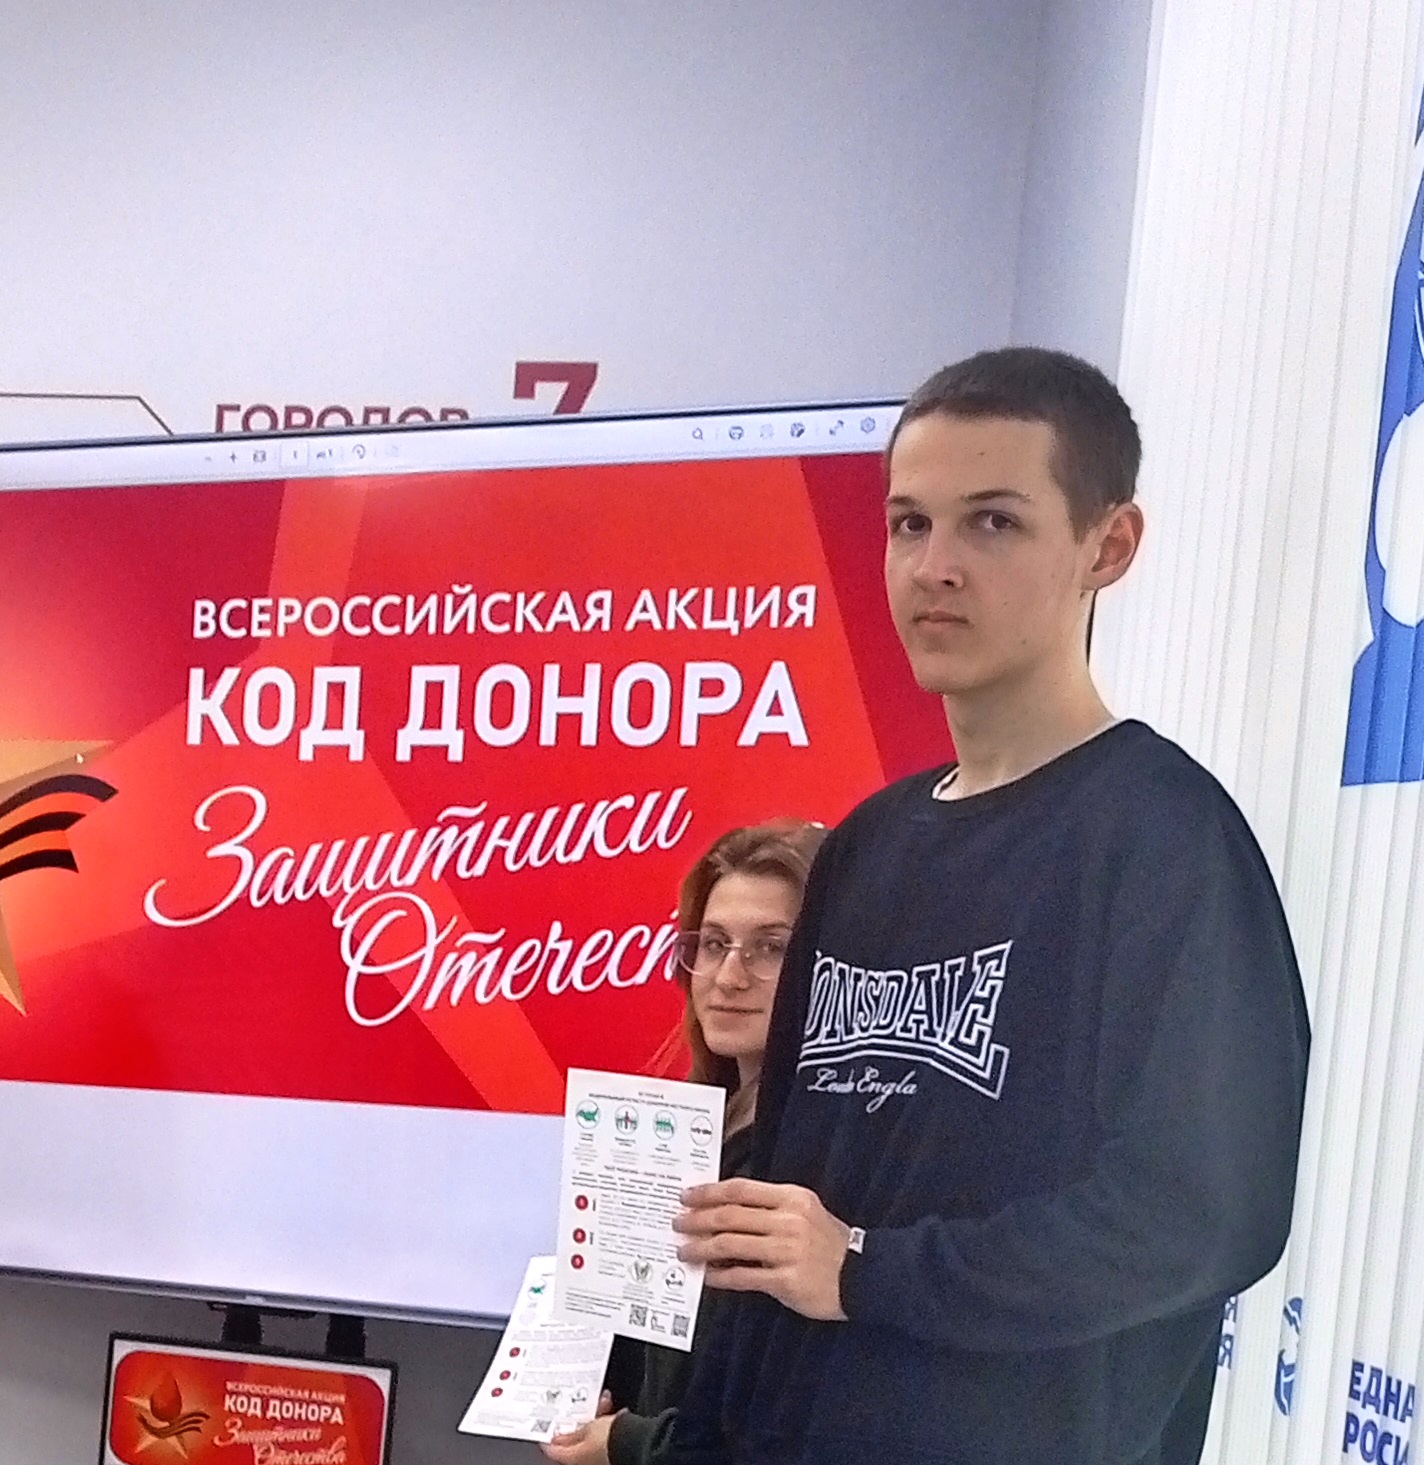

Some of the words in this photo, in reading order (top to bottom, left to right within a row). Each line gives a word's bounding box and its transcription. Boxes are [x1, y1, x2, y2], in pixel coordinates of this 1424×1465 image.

[192, 584, 612, 640] ВСЕРОССИЙСКАЯ
[625, 583, 818, 636] АКЦИЯ
[185, 664, 366, 762] КОД
[395, 660, 811, 762] ДОНОРА
[143, 785, 694, 928] Защитники
[802, 939, 1013, 1069] ONSDALE
[224, 1393, 262, 1419] КОД
[266, 1398, 344, 1425] ДОНОРА
